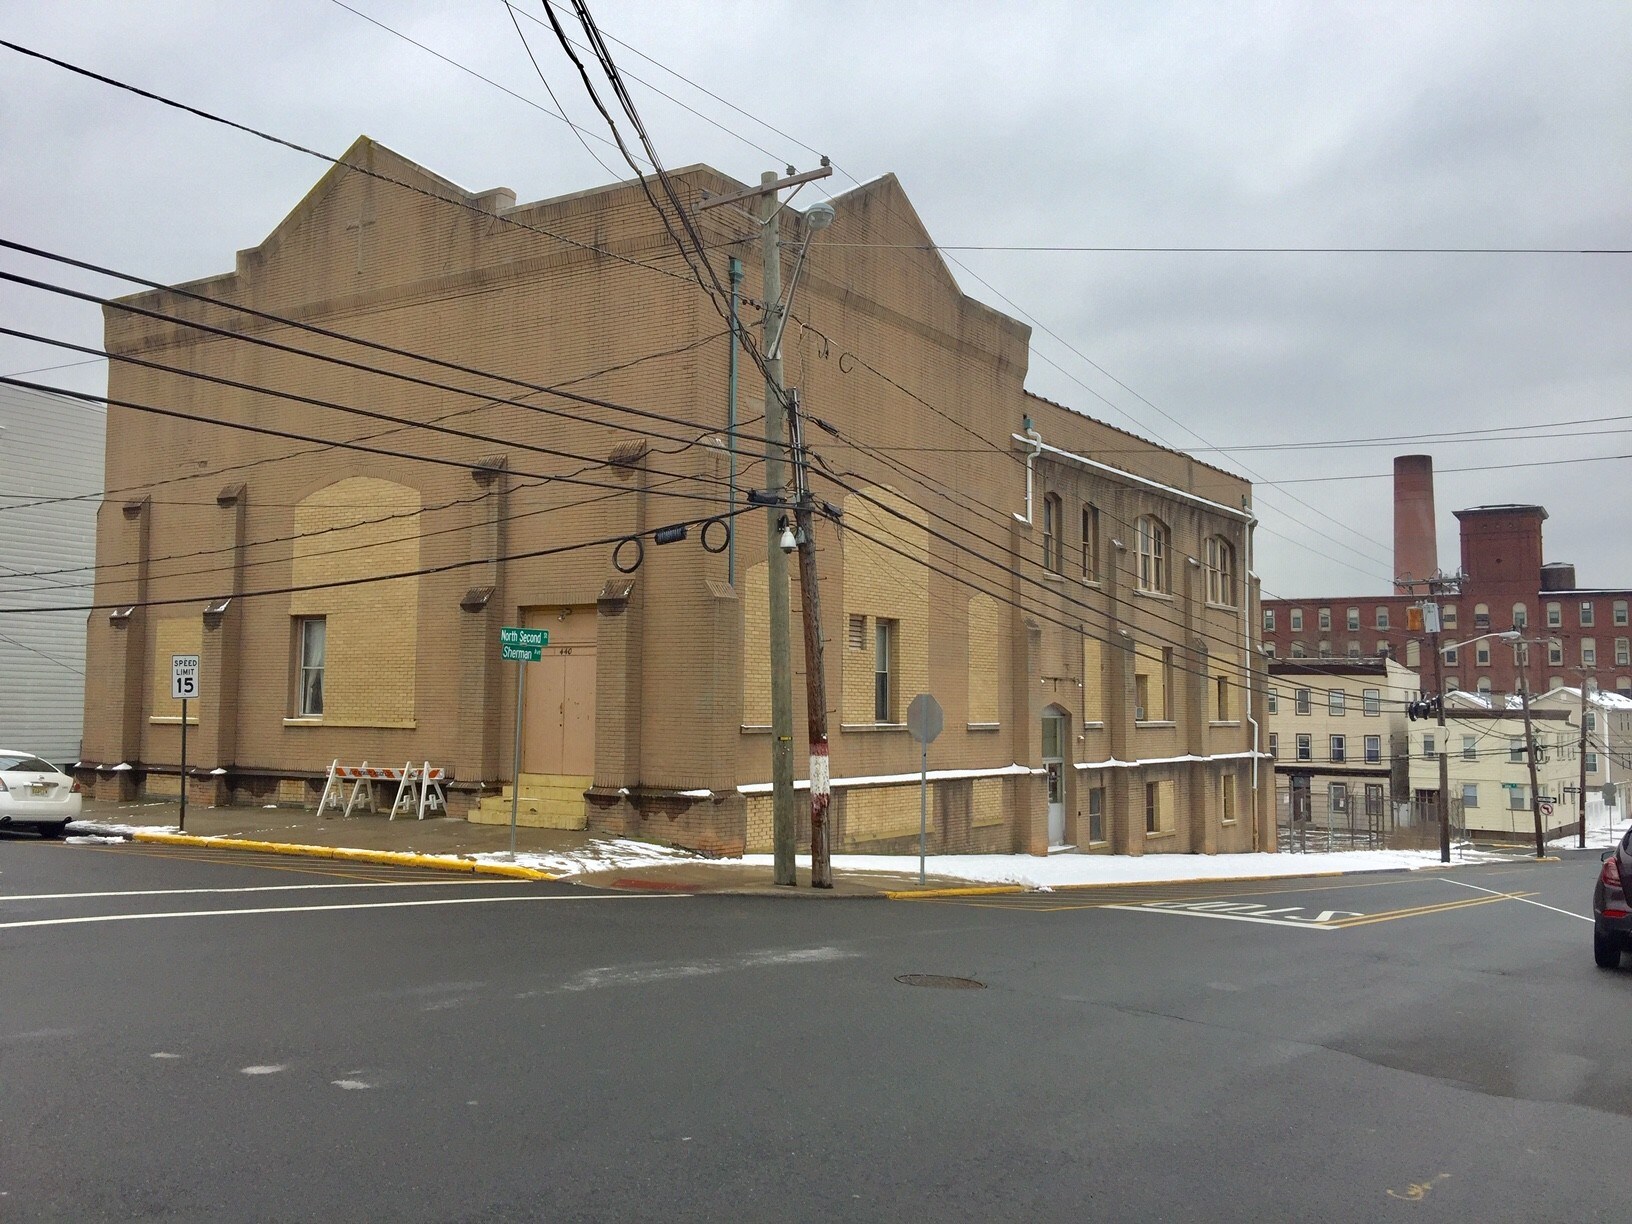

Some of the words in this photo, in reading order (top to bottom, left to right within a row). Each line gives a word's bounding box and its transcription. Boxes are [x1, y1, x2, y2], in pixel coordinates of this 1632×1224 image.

[501, 629, 518, 642] North
[520, 630, 542, 644] Second
[502, 646, 532, 660] Sherman
[560, 647, 573, 655] 440
[174, 659, 198, 667] SPEED
[176, 668, 195, 676] LIMIT
[177, 677, 194, 694] 15
